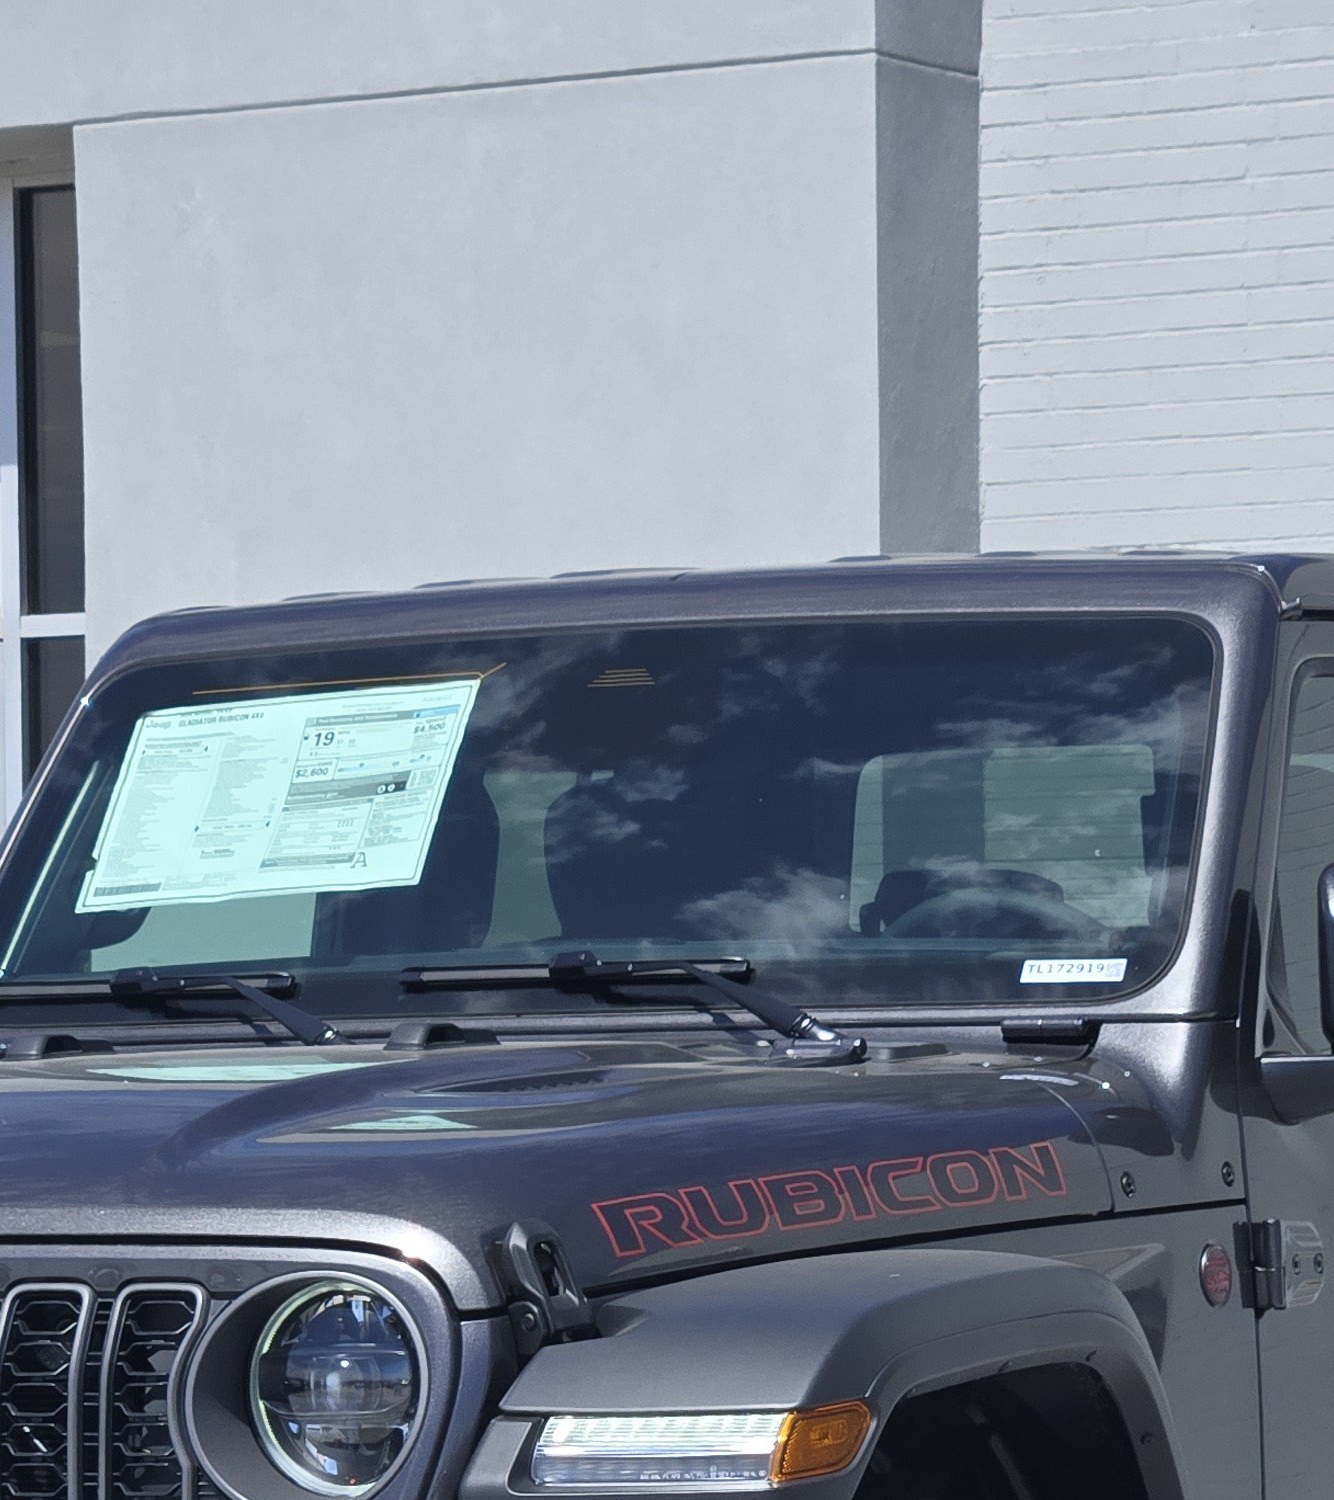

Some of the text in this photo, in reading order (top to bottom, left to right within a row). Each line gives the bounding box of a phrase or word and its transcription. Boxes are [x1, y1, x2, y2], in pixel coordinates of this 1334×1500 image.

[178, 716, 217, 728] GLADIATOR
[218, 714, 249, 724] RUBICON
[313, 731, 335, 748] 19
[295, 767, 329, 778] $2,600
[349, 851, 368, 869] A
[1027, 963, 1105, 974] TL172919
[590, 1141, 1068, 1259] RUBICON
